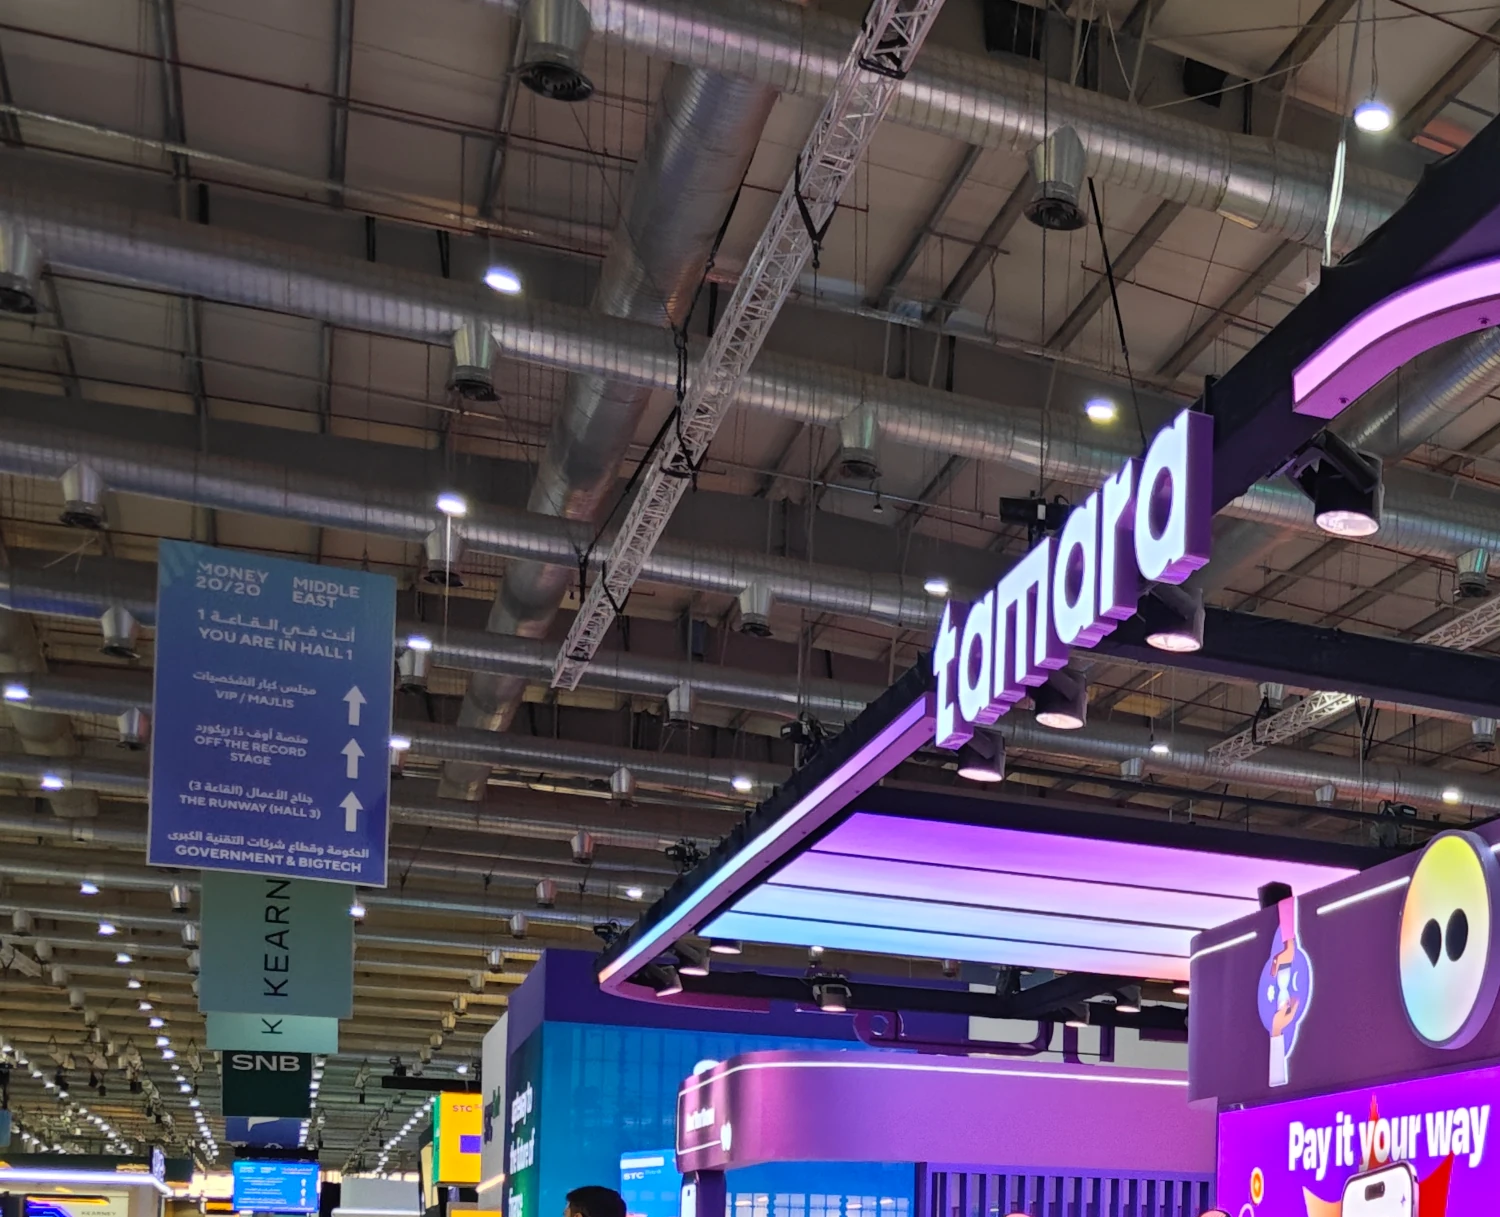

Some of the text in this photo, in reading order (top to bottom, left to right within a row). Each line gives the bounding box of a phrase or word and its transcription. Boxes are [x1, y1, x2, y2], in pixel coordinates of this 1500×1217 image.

[196, 561, 269, 584] MONEY
[932, 410, 1192, 746] tamara
[196, 576, 261, 597] 20/20
[293, 576, 361, 598] MIDDLE
[292, 591, 337, 609] EAST
[198, 609, 355, 643] أنت في القاعة 1
[199, 627, 353, 661] YOU ARE IN HALL 1
[215, 689, 238, 700] VIP
[247, 694, 295, 708] MAJLIS
[195, 724, 231, 737] ريكورد
[275, 731, 309, 745] منصة
[194, 735, 307, 757] OFF THE RECORD
[230, 752, 272, 766] STAGE
[246, 787, 289, 801] الأعمال
[290, 792, 313, 806] جناح
[179, 794, 321, 820] THE RUNWAY (HALL 3)
[167, 830, 369, 859] الحكومة وقطاع شركات التقنية الكبرى
[175, 844, 362, 873] GOVERNMENT & BIGTECH
[263, 879, 292, 997] KEARN
[231, 1054, 301, 1072] SNB
[1288, 1104, 1490, 1181] Pay it your way
[623, 1172, 644, 1180] STC
